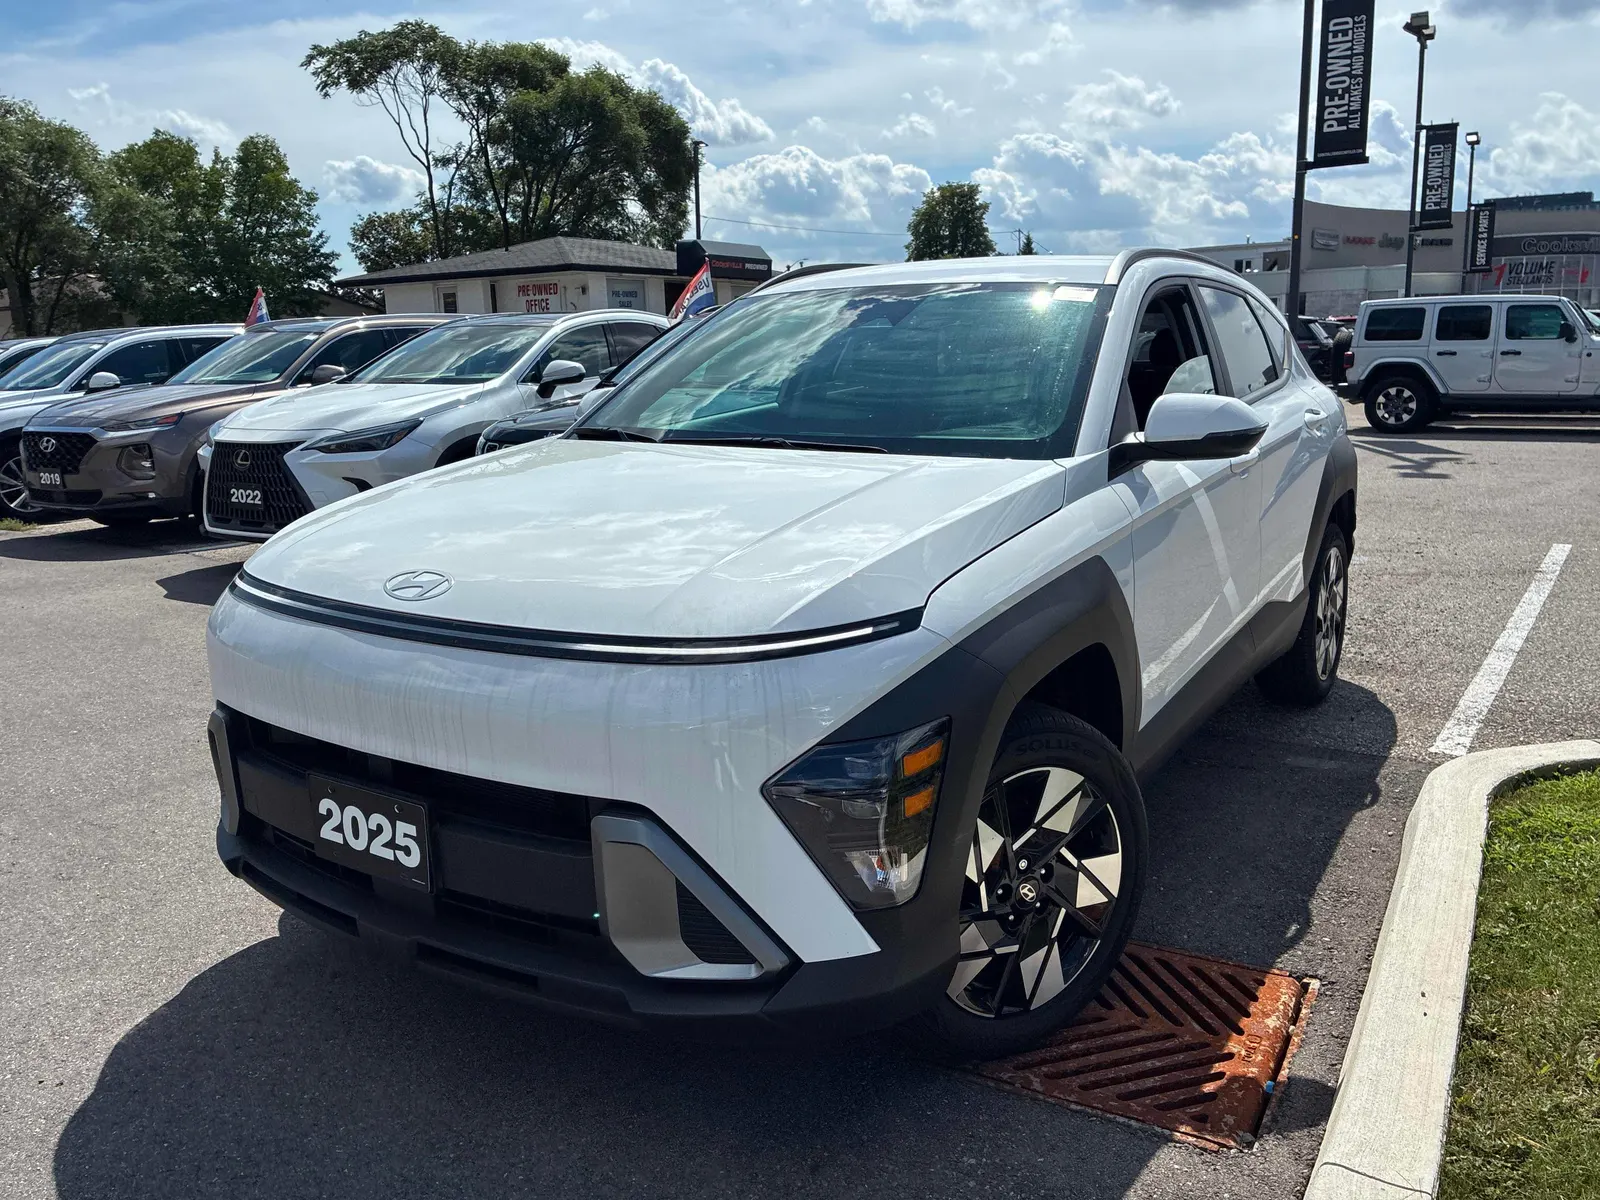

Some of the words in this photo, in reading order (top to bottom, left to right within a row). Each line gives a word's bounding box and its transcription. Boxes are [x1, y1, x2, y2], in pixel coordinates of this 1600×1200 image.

[1353, 14, 1367, 53] MODELS
[1352, 54, 1364, 75] AND
[1323, 16, 1353, 133] PRE-OWNED
[1350, 78, 1363, 110] MAKES
[1348, 111, 1360, 129] ALL
[1425, 144, 1444, 210] PRE-OWNED
[1479, 210, 1489, 232] PARTS
[1476, 239, 1488, 265] SERVICE
[744, 262, 768, 271] PREOWNED
[1508, 260, 1556, 275] VOLUME
[1506, 274, 1554, 285] STELLANTIS
[517, 282, 558, 297] PRE-OWNED
[611, 290, 638, 298] PRE-OWNED
[525, 298, 550, 313] OFFICE
[618, 300, 633, 308] SALES
[39, 472, 61, 486] 2019
[229, 488, 262, 505] 2022
[318, 797, 421, 868] 2025
